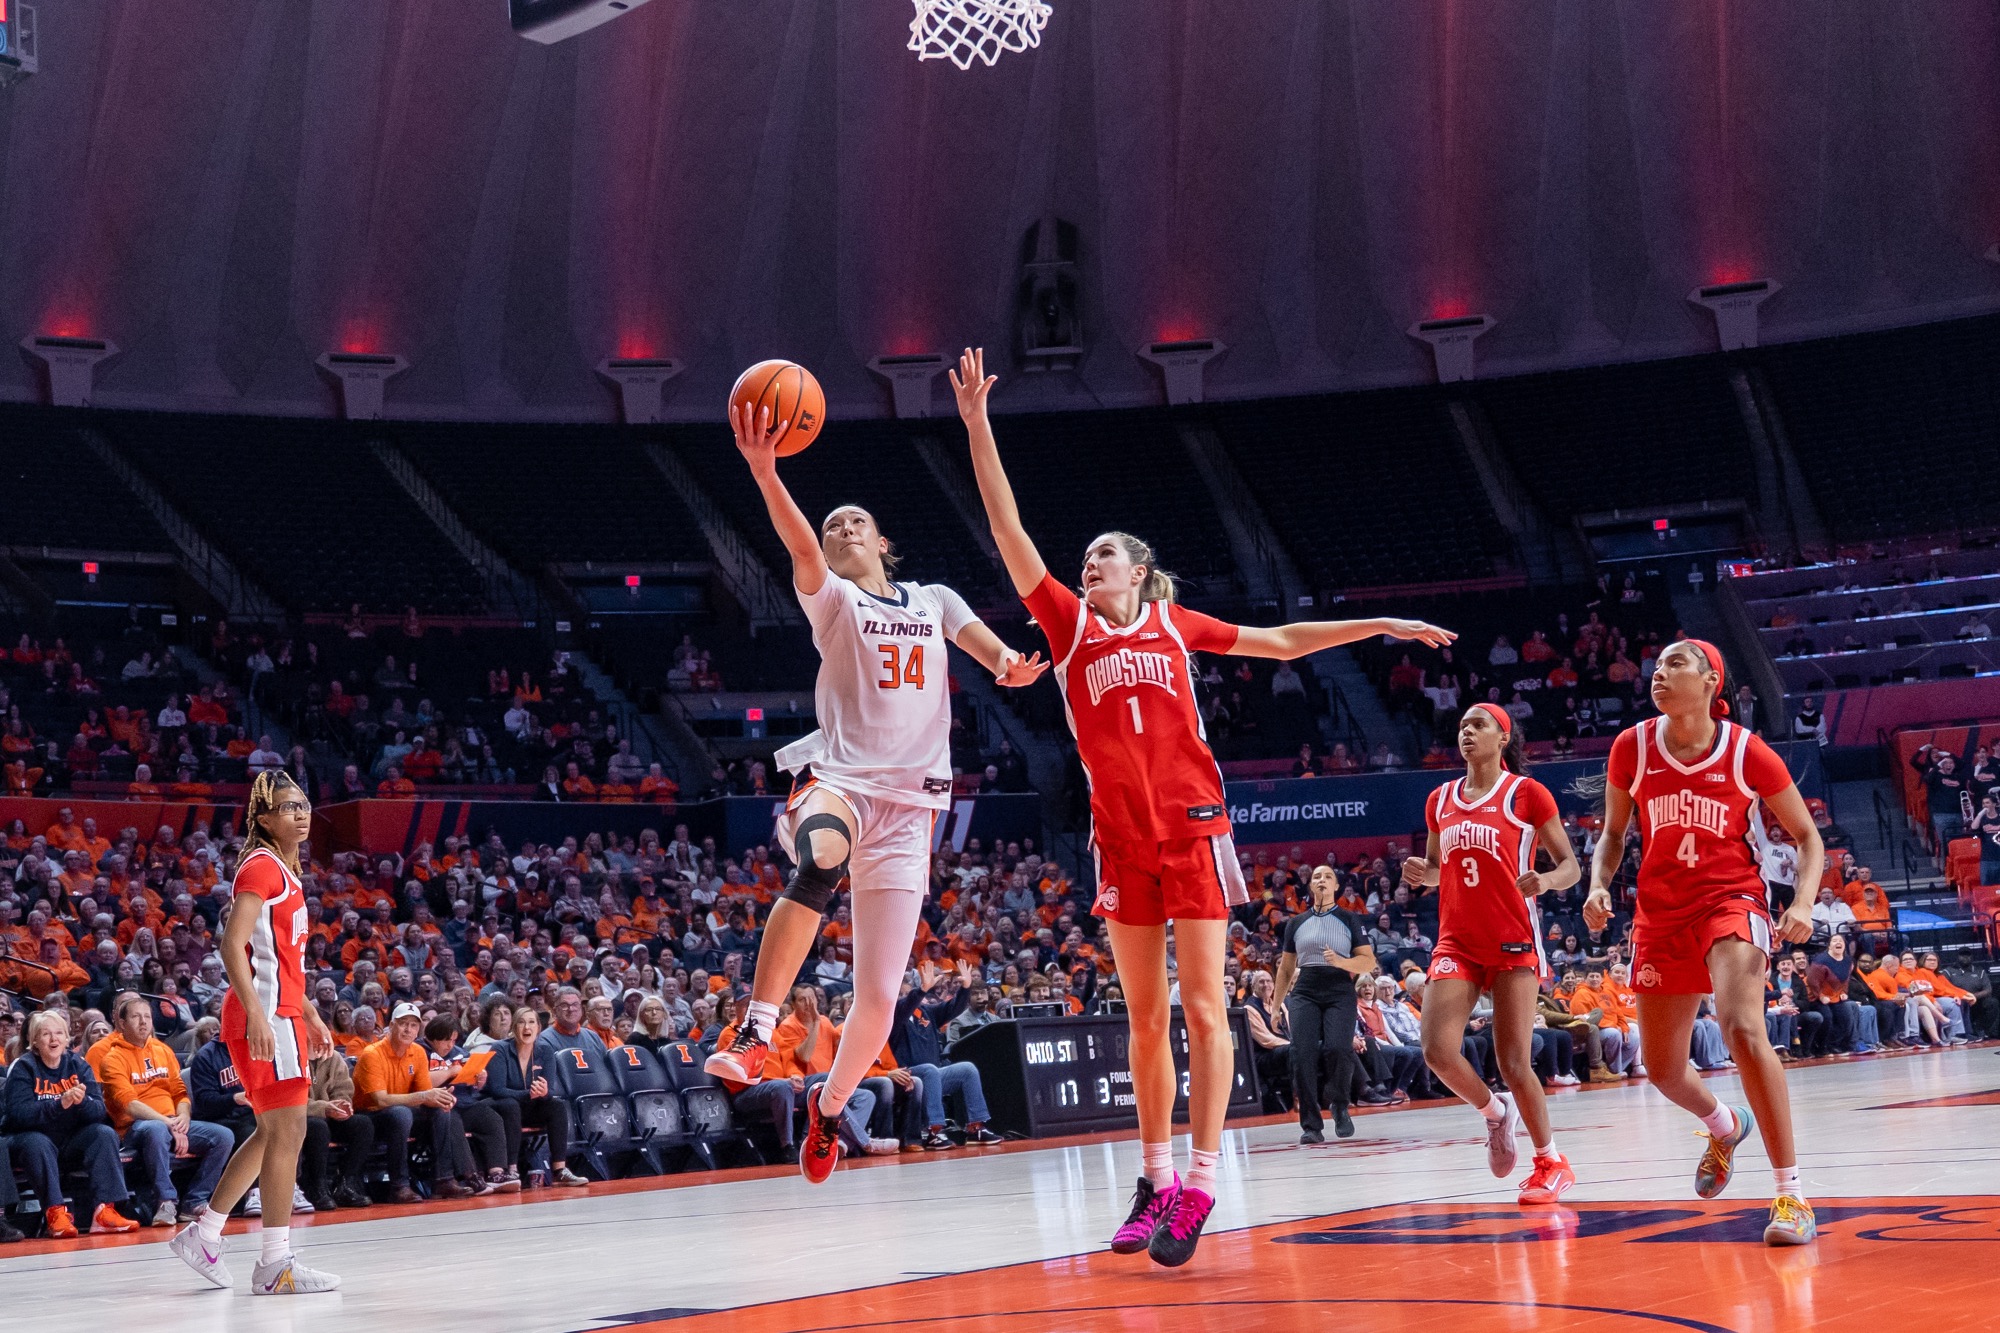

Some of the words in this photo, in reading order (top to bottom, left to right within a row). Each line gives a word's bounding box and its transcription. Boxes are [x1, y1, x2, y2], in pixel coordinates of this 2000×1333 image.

[863, 620, 933, 638] ILLINOIS
[878, 645, 925, 690] 34
[1126, 695, 1144, 735] 1
[1301, 802, 1366, 820] CENTER
[1676, 832, 1699, 869] 4
[1461, 857, 1480, 887] 3
[1087, 1035, 1093, 1046] B
[1026, 1042, 1054, 1064] OHIO
[1057, 1041, 1072, 1062] ST
[1089, 1048, 1095, 1059] B
[1109, 1071, 1133, 1084] FOULS
[1060, 1080, 1079, 1106] 17
[1099, 1077, 1110, 1104] 3
[1114, 1094, 1136, 1106] PERIO
